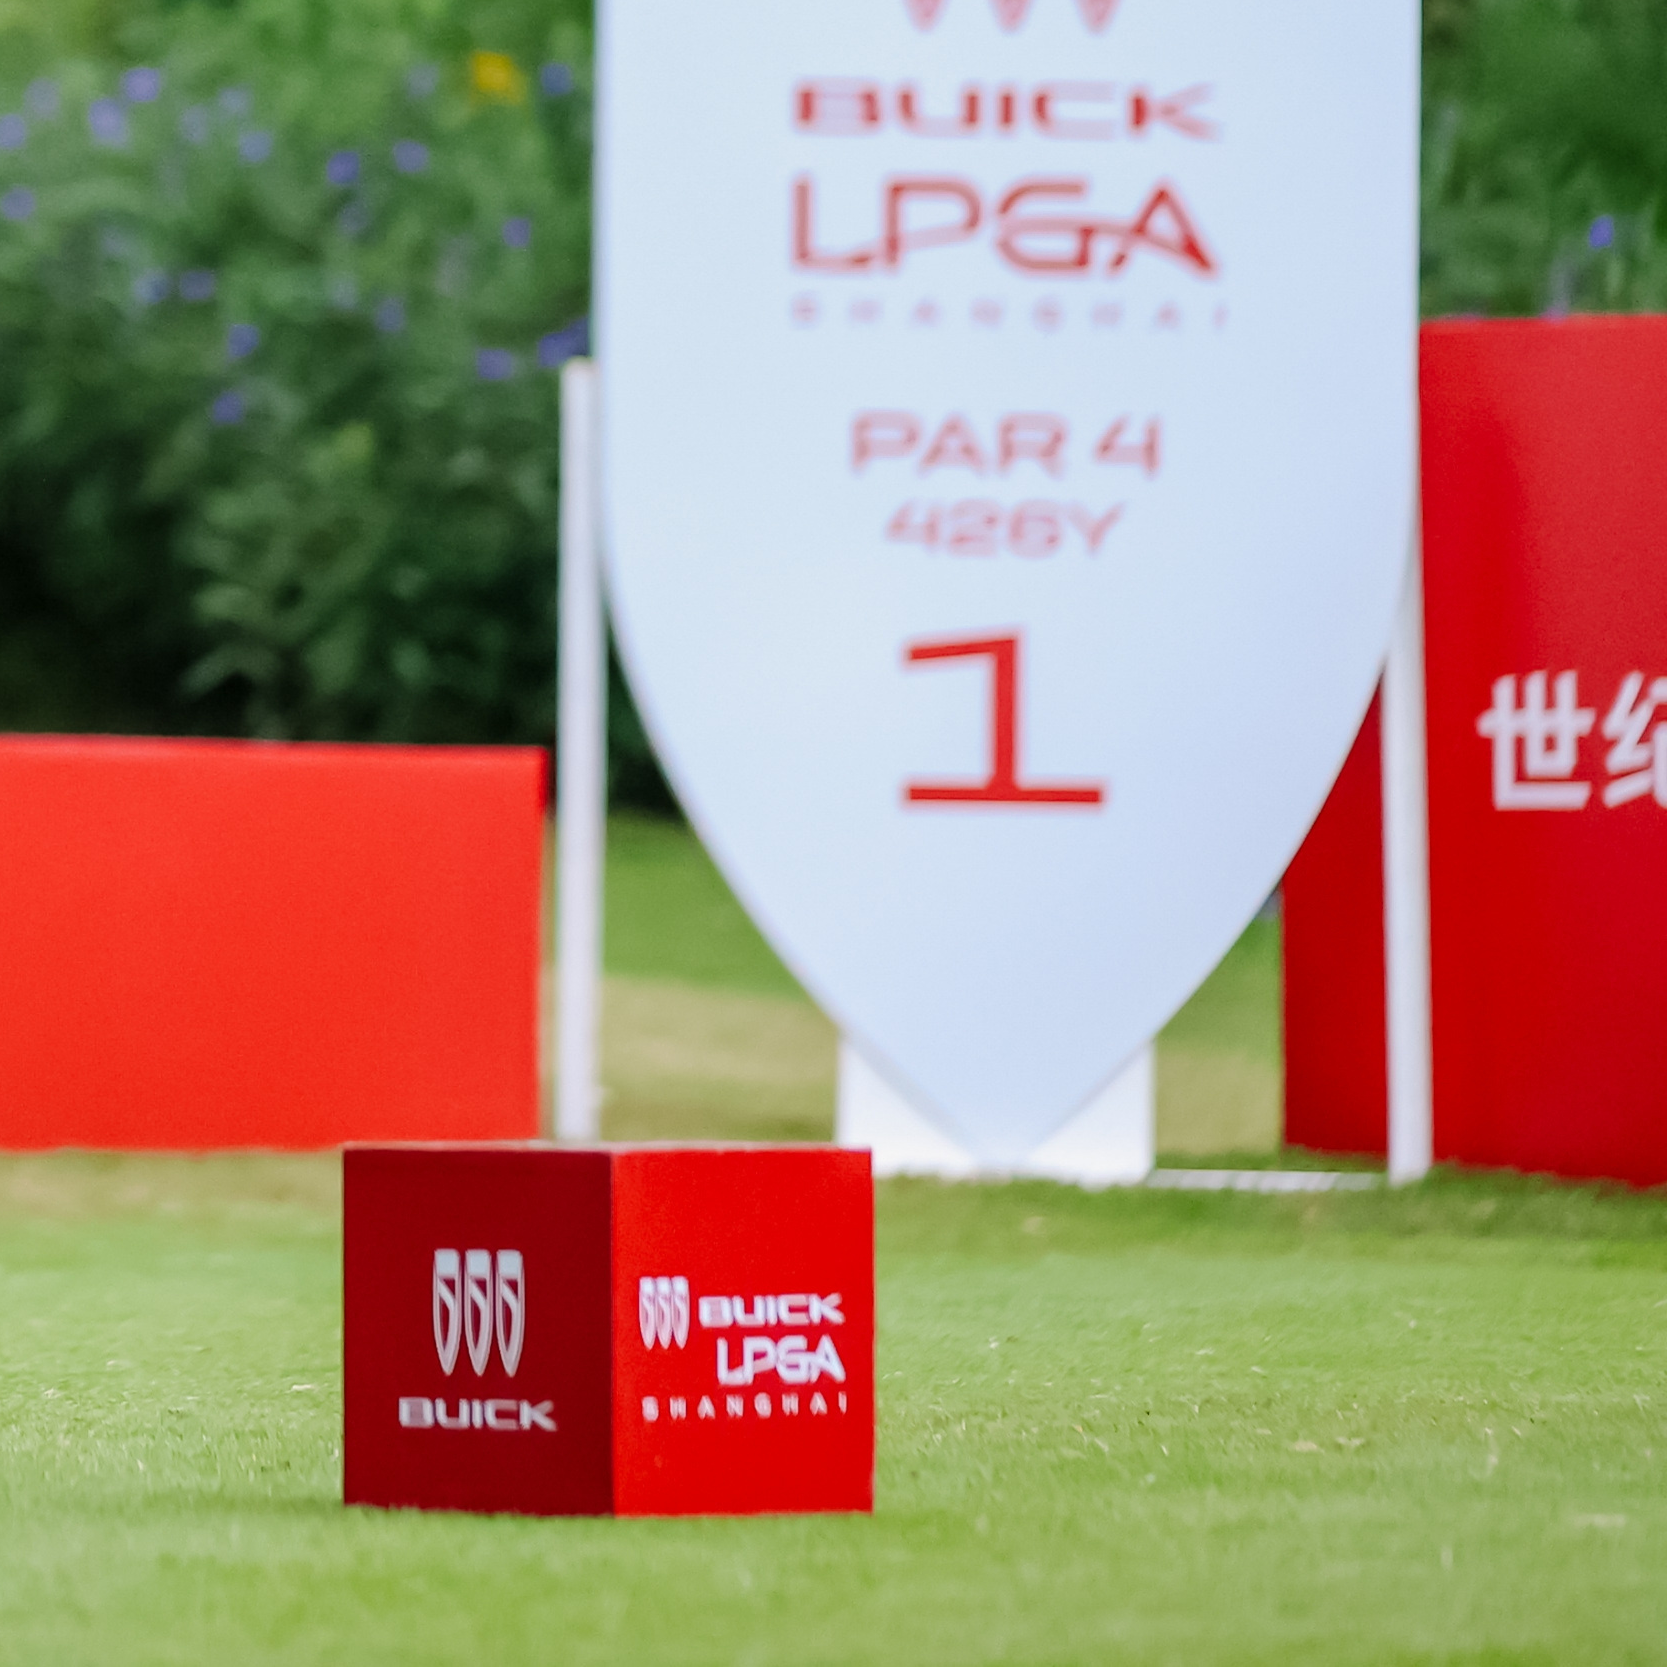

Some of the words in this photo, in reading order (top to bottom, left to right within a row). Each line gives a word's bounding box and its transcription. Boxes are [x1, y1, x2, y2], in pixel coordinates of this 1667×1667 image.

[792, 79, 1223, 140] BUICK
[791, 172, 1220, 280] LPGA
[850, 410, 1068, 478] PAR
[1092, 413, 1163, 480] 4
[884, 497, 1128, 558] 426Y
[901, 627, 1106, 809] 1
[698, 1292, 846, 1328] BUICK
[716, 1334, 846, 1386] LPGA
[398, 1396, 559, 1432] BUICK
[641, 1391, 848, 1422] SHANGHAI
